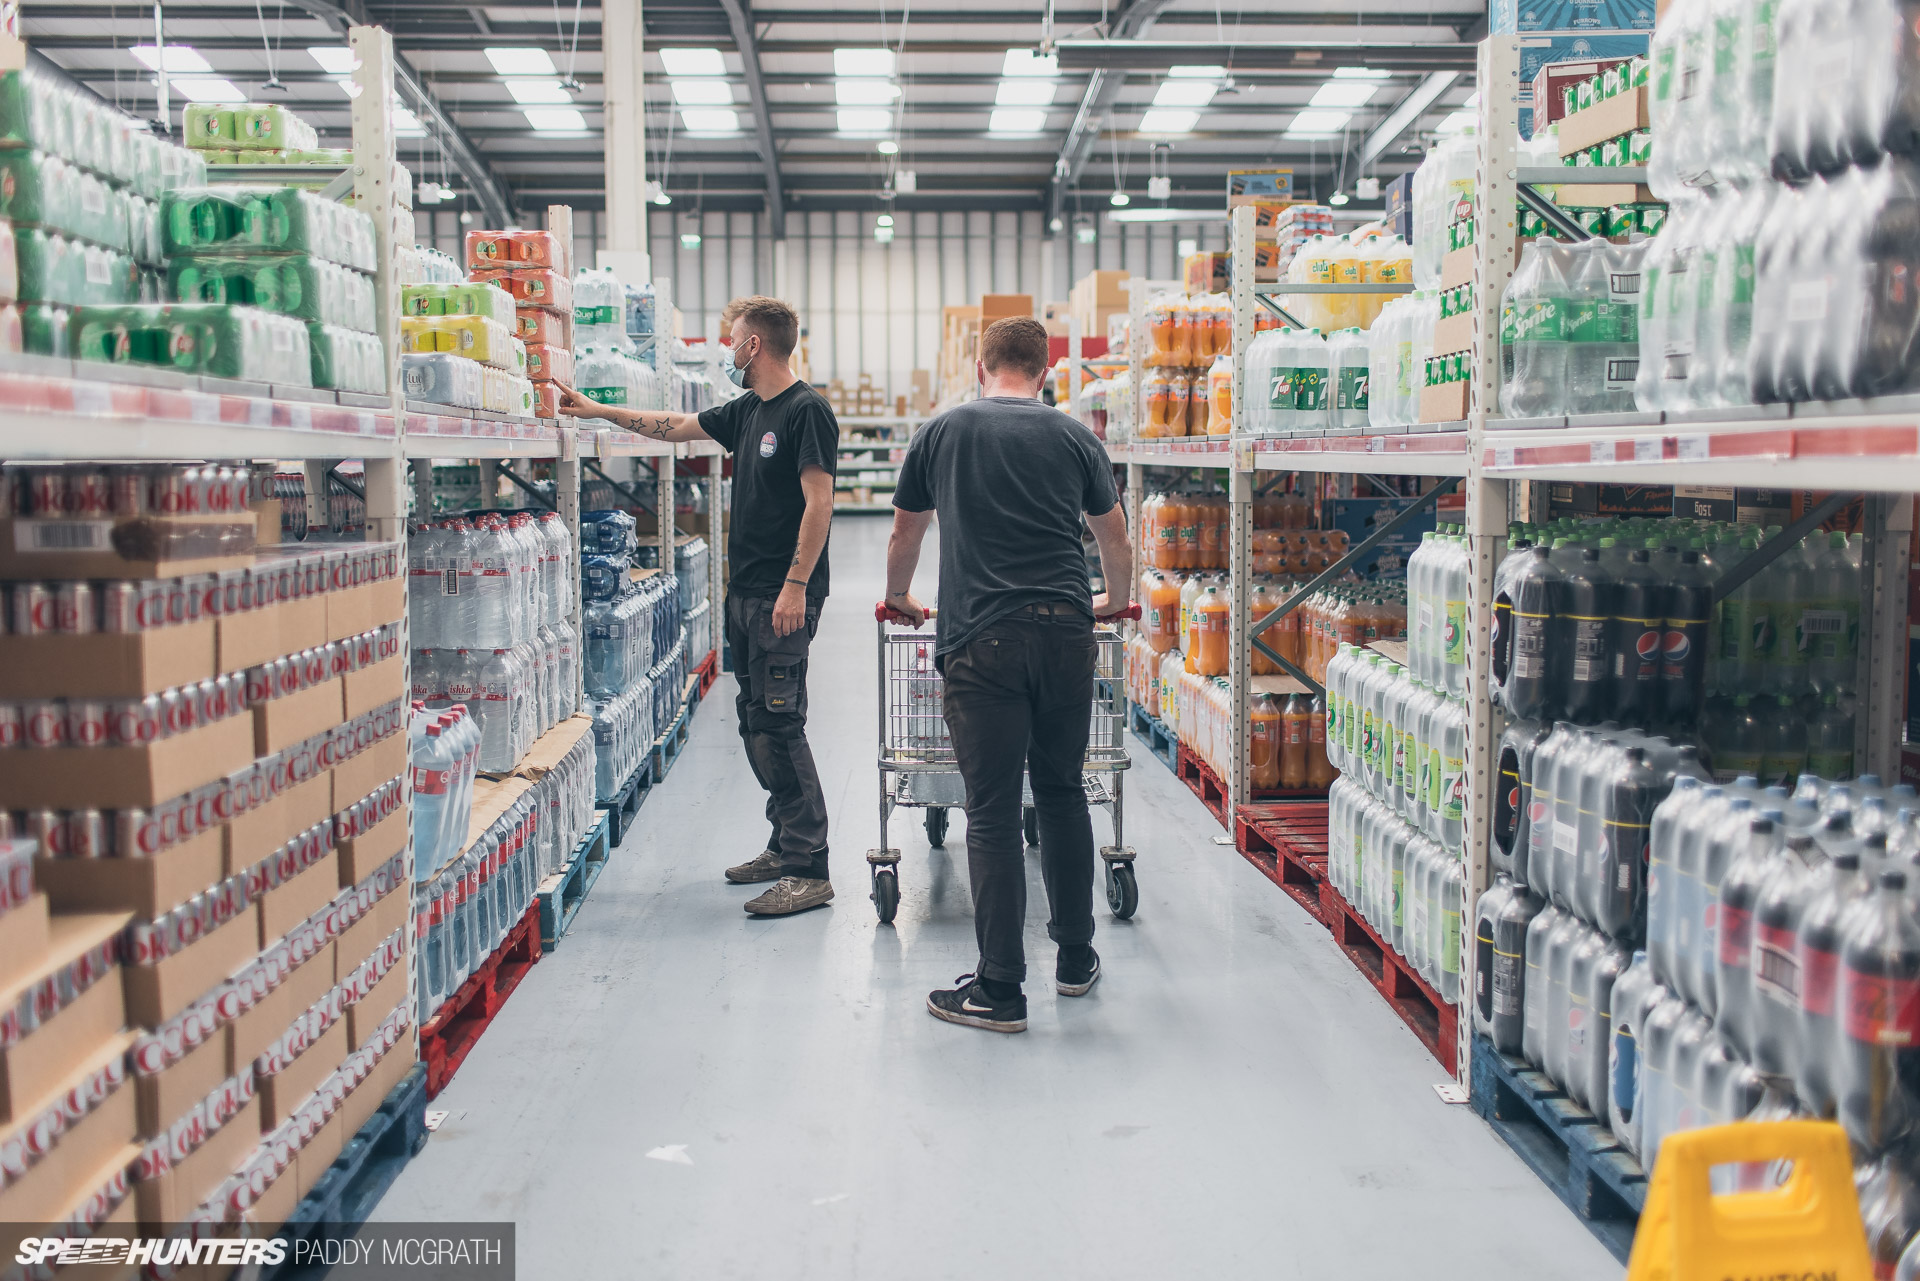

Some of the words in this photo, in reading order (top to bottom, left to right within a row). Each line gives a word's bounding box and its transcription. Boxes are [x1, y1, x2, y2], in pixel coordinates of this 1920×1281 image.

[1514, 304, 1555, 339] Sprite
[1271, 375, 1290, 400] 7up
[1694, 501, 1711, 517] 150g
[449, 683, 472, 694] ishka
